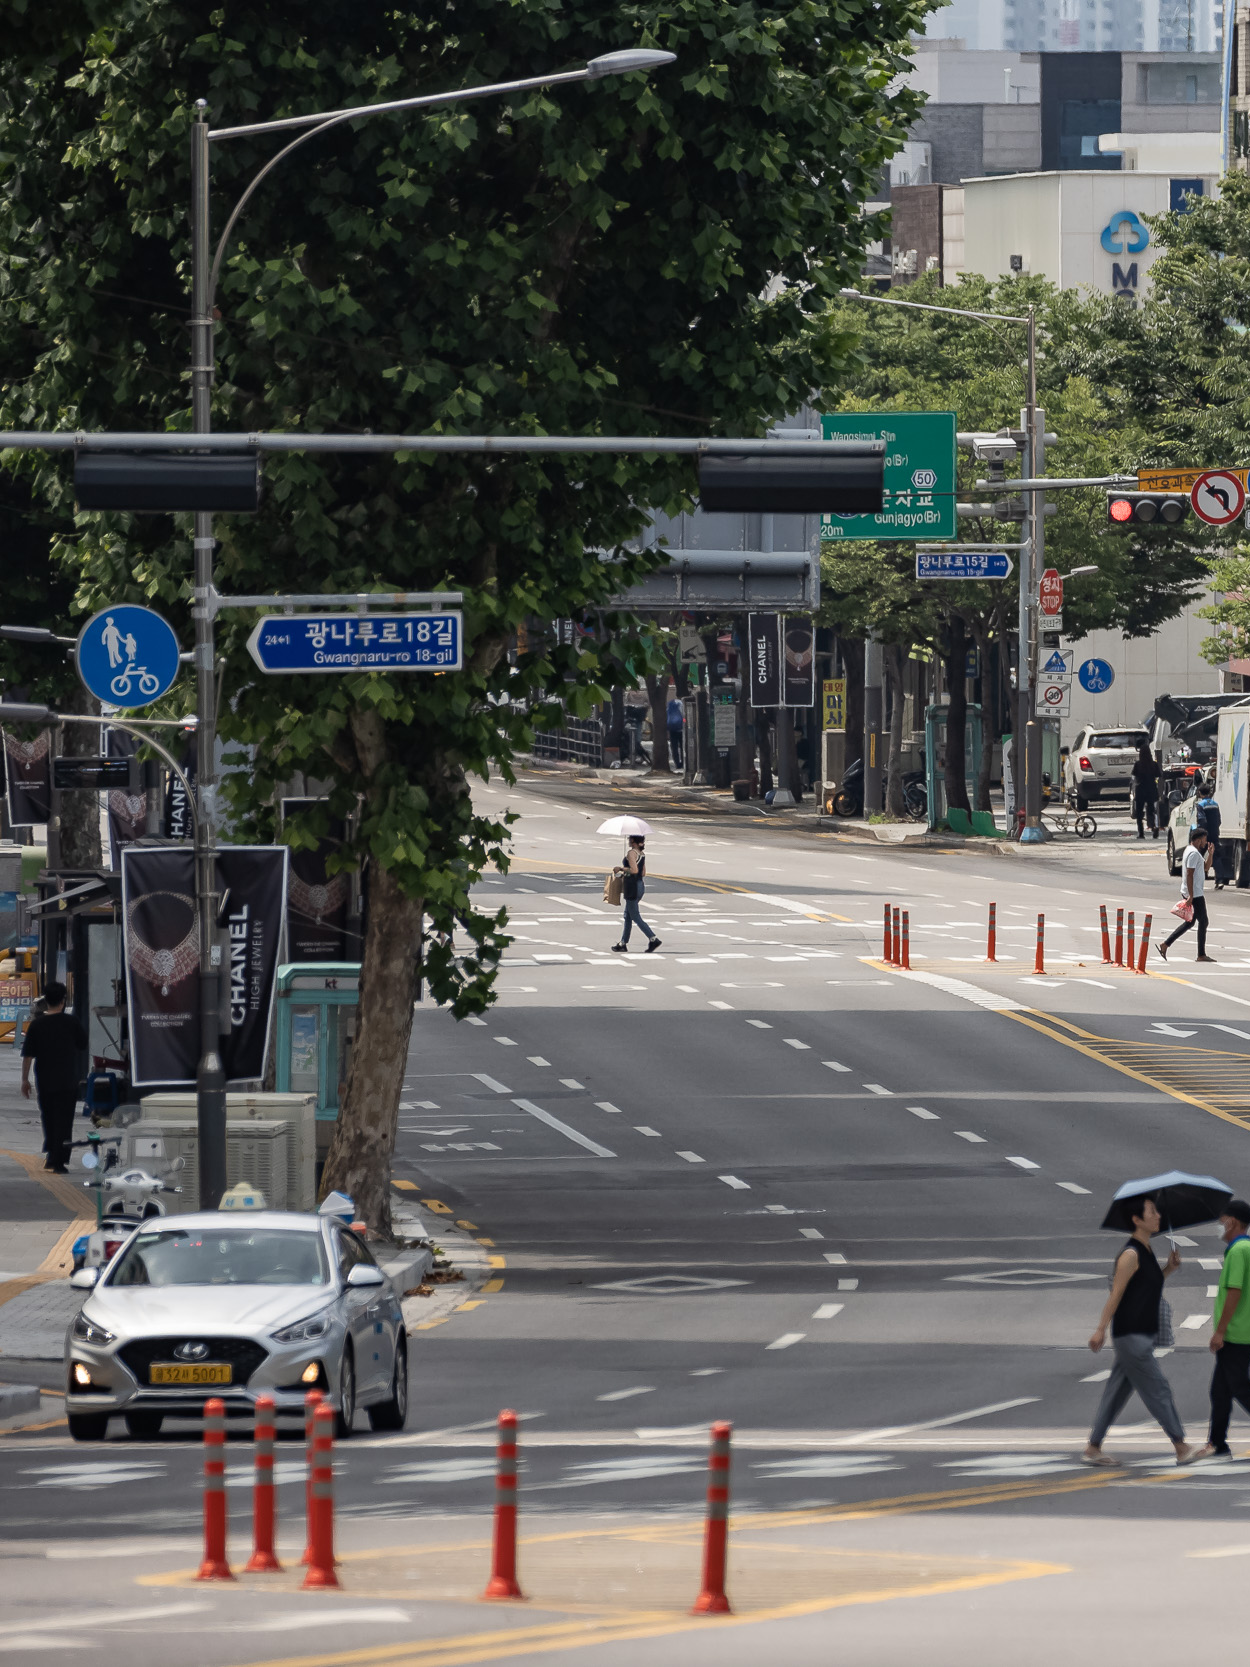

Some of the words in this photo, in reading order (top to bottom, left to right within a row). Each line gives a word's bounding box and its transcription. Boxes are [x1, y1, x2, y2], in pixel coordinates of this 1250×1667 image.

[880, 430, 896, 441] Stn
[917, 473, 932, 484] 50
[874, 510, 941, 527] Gunjagyo(Br)
[919, 556, 988, 568] 광나루로15길
[1043, 576, 1060, 592] 정지
[1042, 595, 1060, 608] STOP
[305, 619, 453, 648] 광나루로18길
[313, 650, 411, 665] Gwangnaru-ro
[415, 649, 453, 664] 18-gil
[757, 635, 767, 684] CHANEL
[170, 767, 188, 839] HANEL
[251, 919, 264, 972] JEWELRY
[228, 904, 249, 1026] CHANEL
[325, 978, 337, 989] kt
[250, 975, 261, 1010] HIGH
[192, 1368, 223, 1382] 5001
